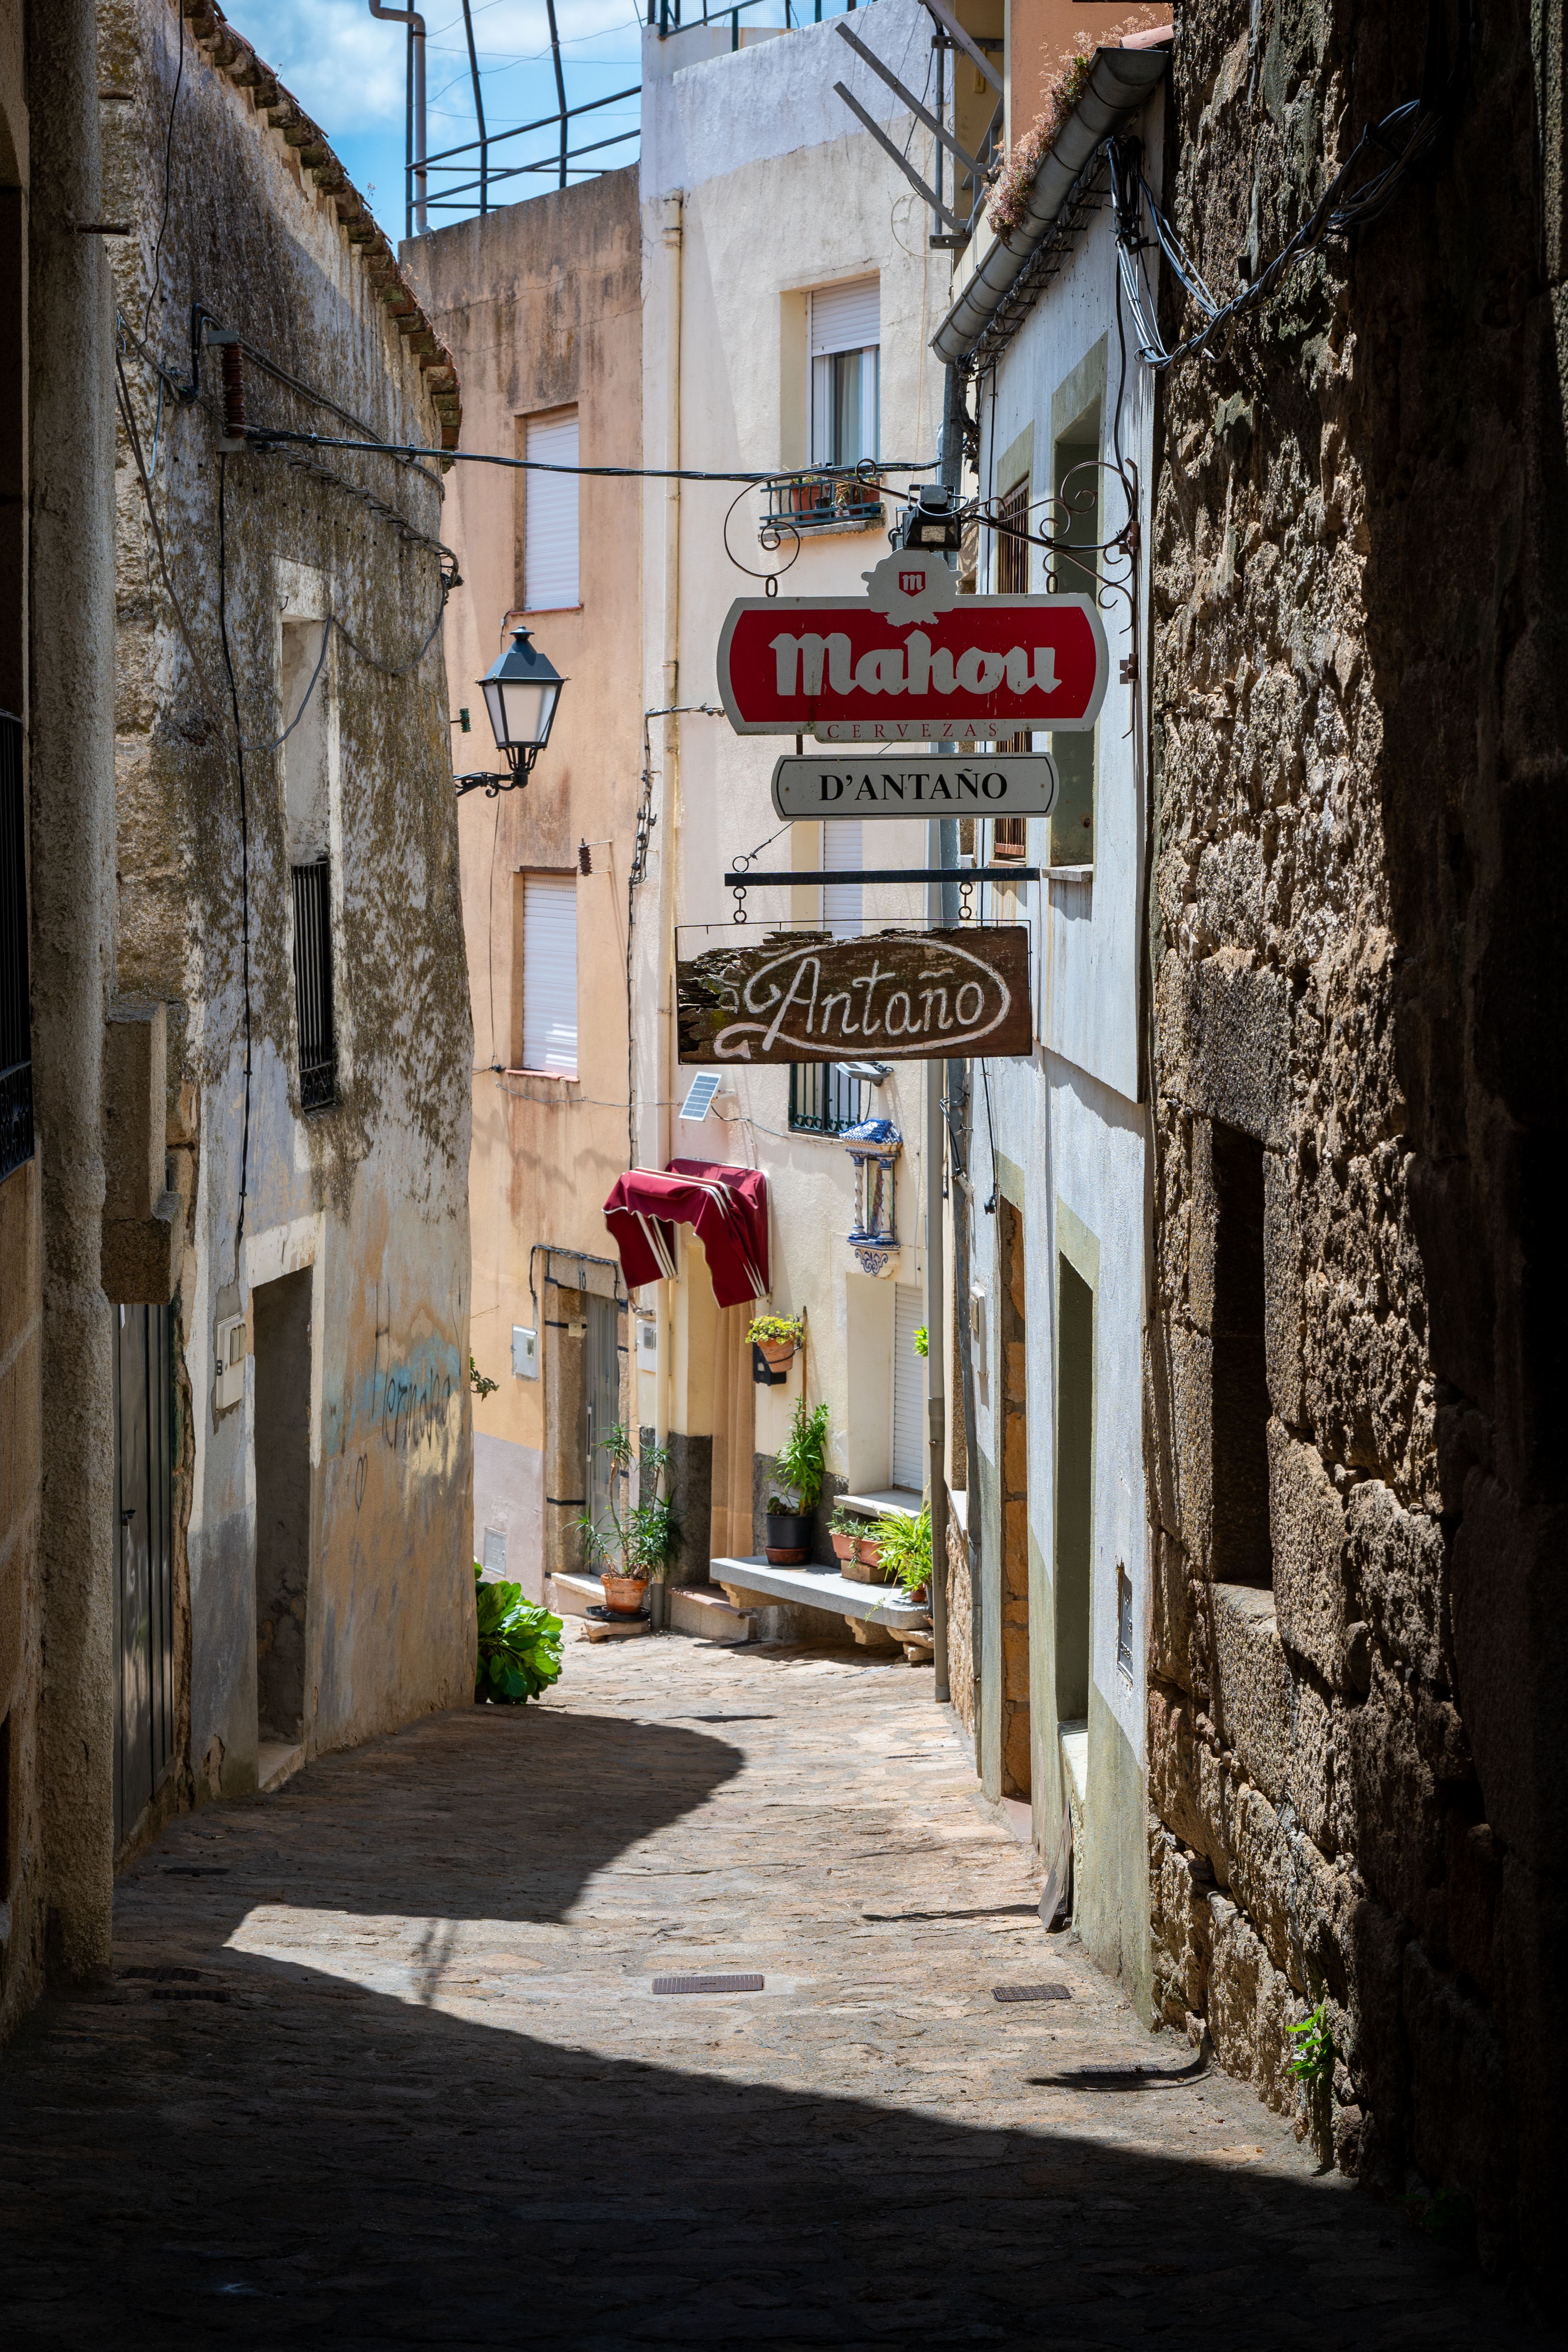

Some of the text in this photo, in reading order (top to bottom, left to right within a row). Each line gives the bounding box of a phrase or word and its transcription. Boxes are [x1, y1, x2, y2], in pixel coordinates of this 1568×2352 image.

[768, 630, 1062, 696] Mahou
[827, 722, 998, 739] CERVEZAS
[818, 768, 1008, 801] D'ANTAÑO
[762, 956, 985, 1051] Antaño
